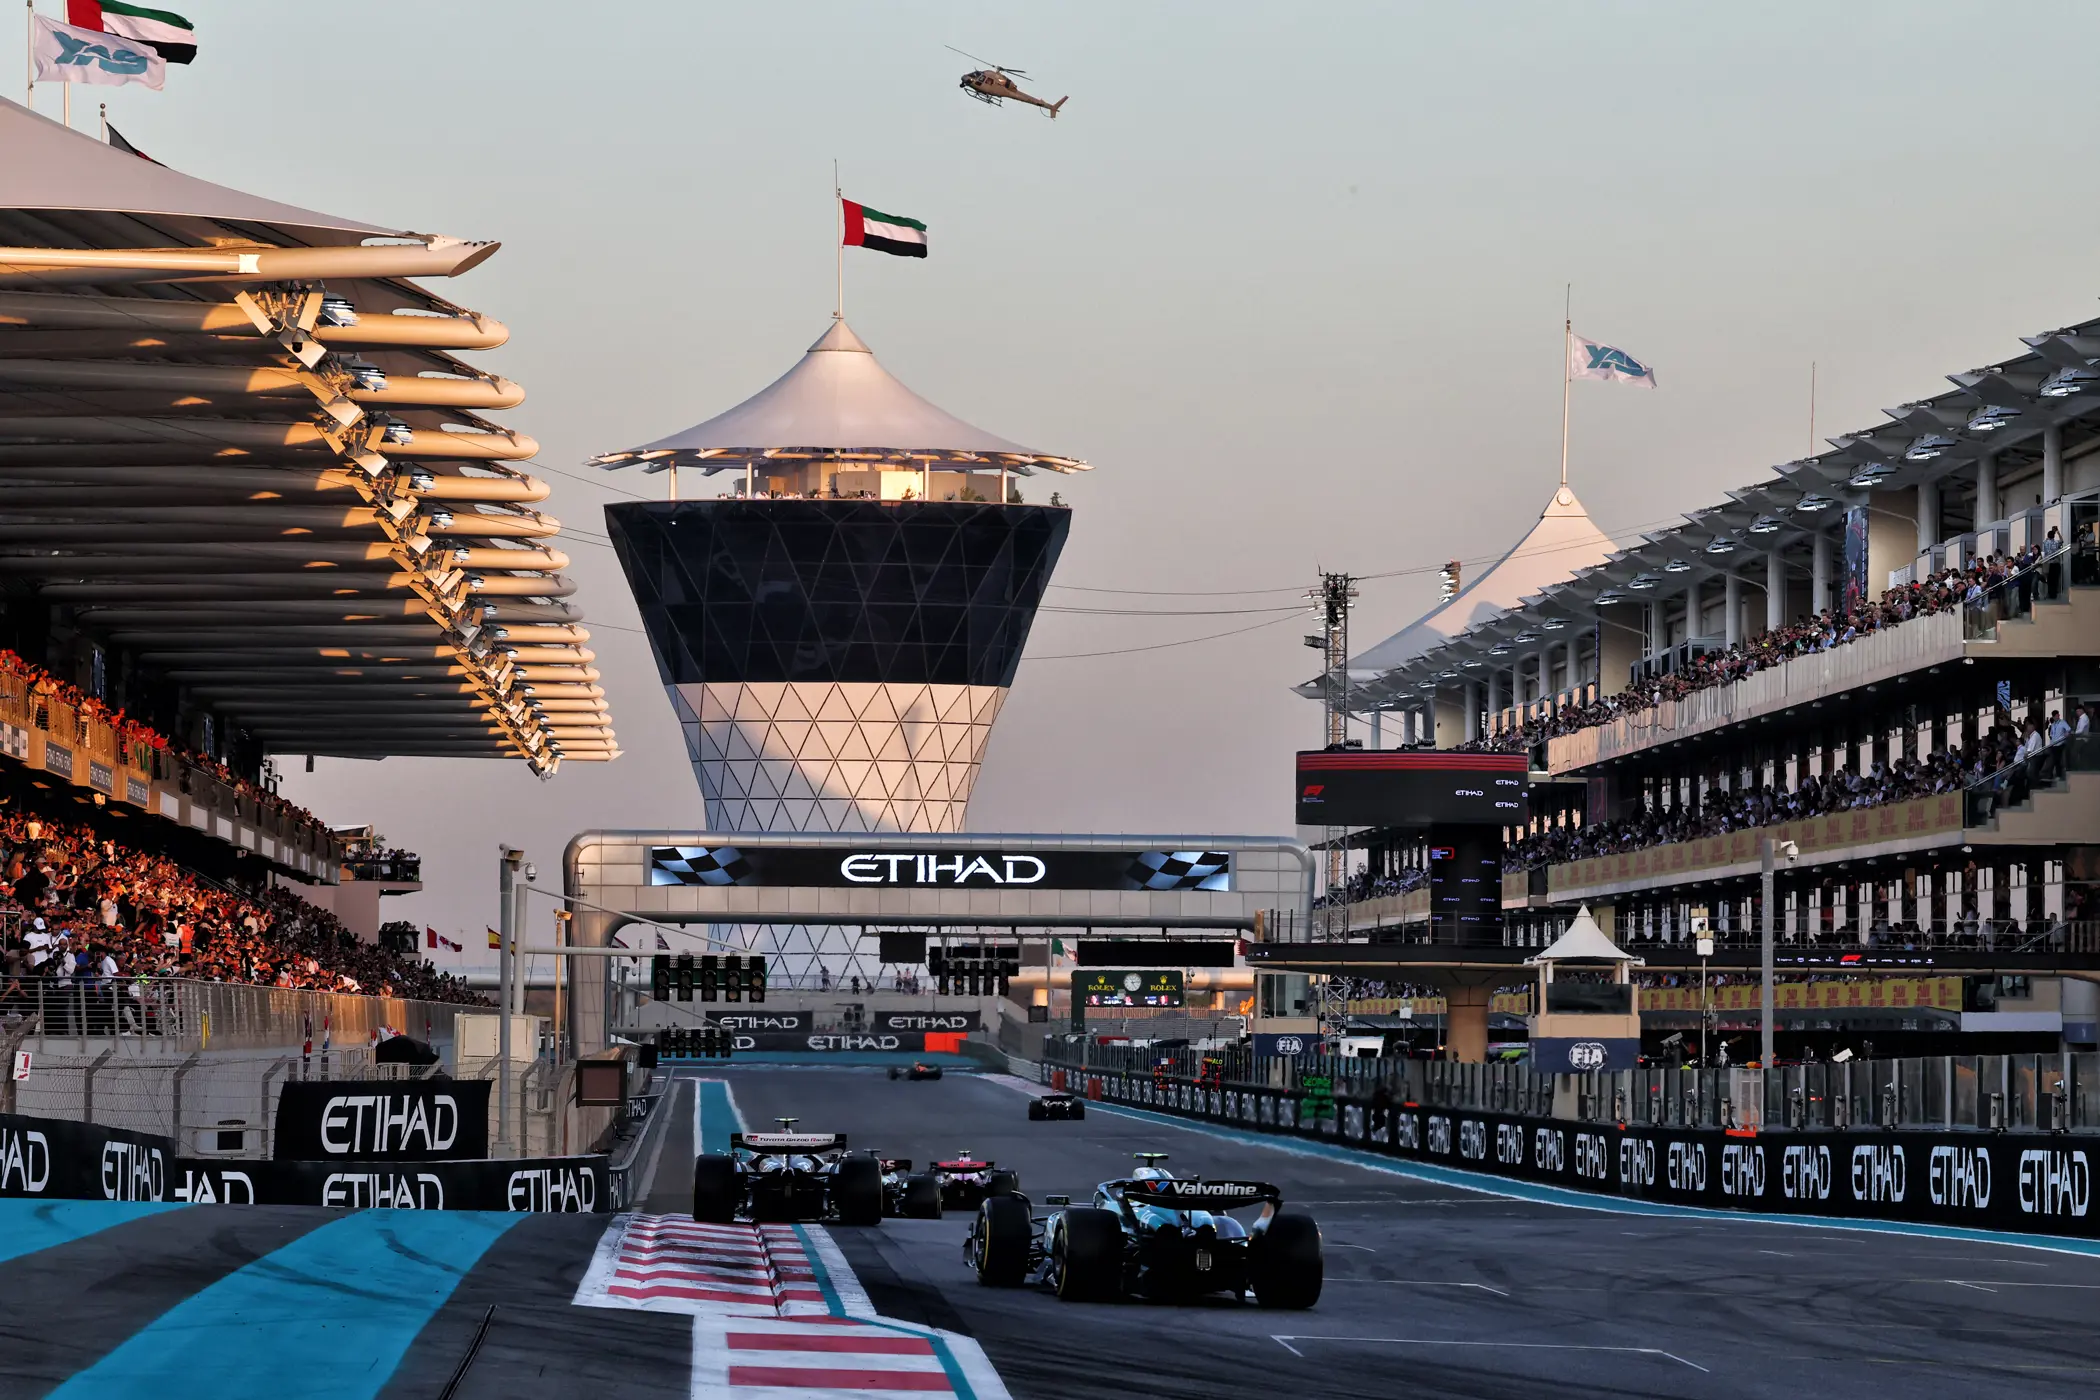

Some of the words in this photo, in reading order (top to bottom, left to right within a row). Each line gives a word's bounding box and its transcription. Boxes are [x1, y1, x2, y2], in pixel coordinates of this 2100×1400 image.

[840, 854, 1046, 884] ETIHAD
[720, 1016, 798, 1029] ETIHAD
[807, 1034, 900, 1050] ETIHAD
[888, 1016, 967, 1029] ETIHAD
[321, 1095, 458, 1153] ETIHAD
[102, 1141, 164, 1202] ETIHAD
[1536, 1128, 1564, 1172] ETIHAD
[1575, 1133, 1607, 1179] ETIHAD
[1620, 1138, 1655, 1185] ETIHAD
[1668, 1142, 1706, 1191] ETIHAD
[1722, 1144, 1765, 1196] ETIHAD
[1783, 1145, 1831, 1199] ETIHAD
[322, 1173, 444, 1211] ETIHAD
[507, 1167, 595, 1213] ETIHAD
[1173, 1181, 1257, 1196] Valvoline
[1851, 1145, 1905, 1202] ETIHAD
[1930, 1145, 1991, 1208] ETIHAD
[2019, 1149, 2089, 1217] ETIHAD
